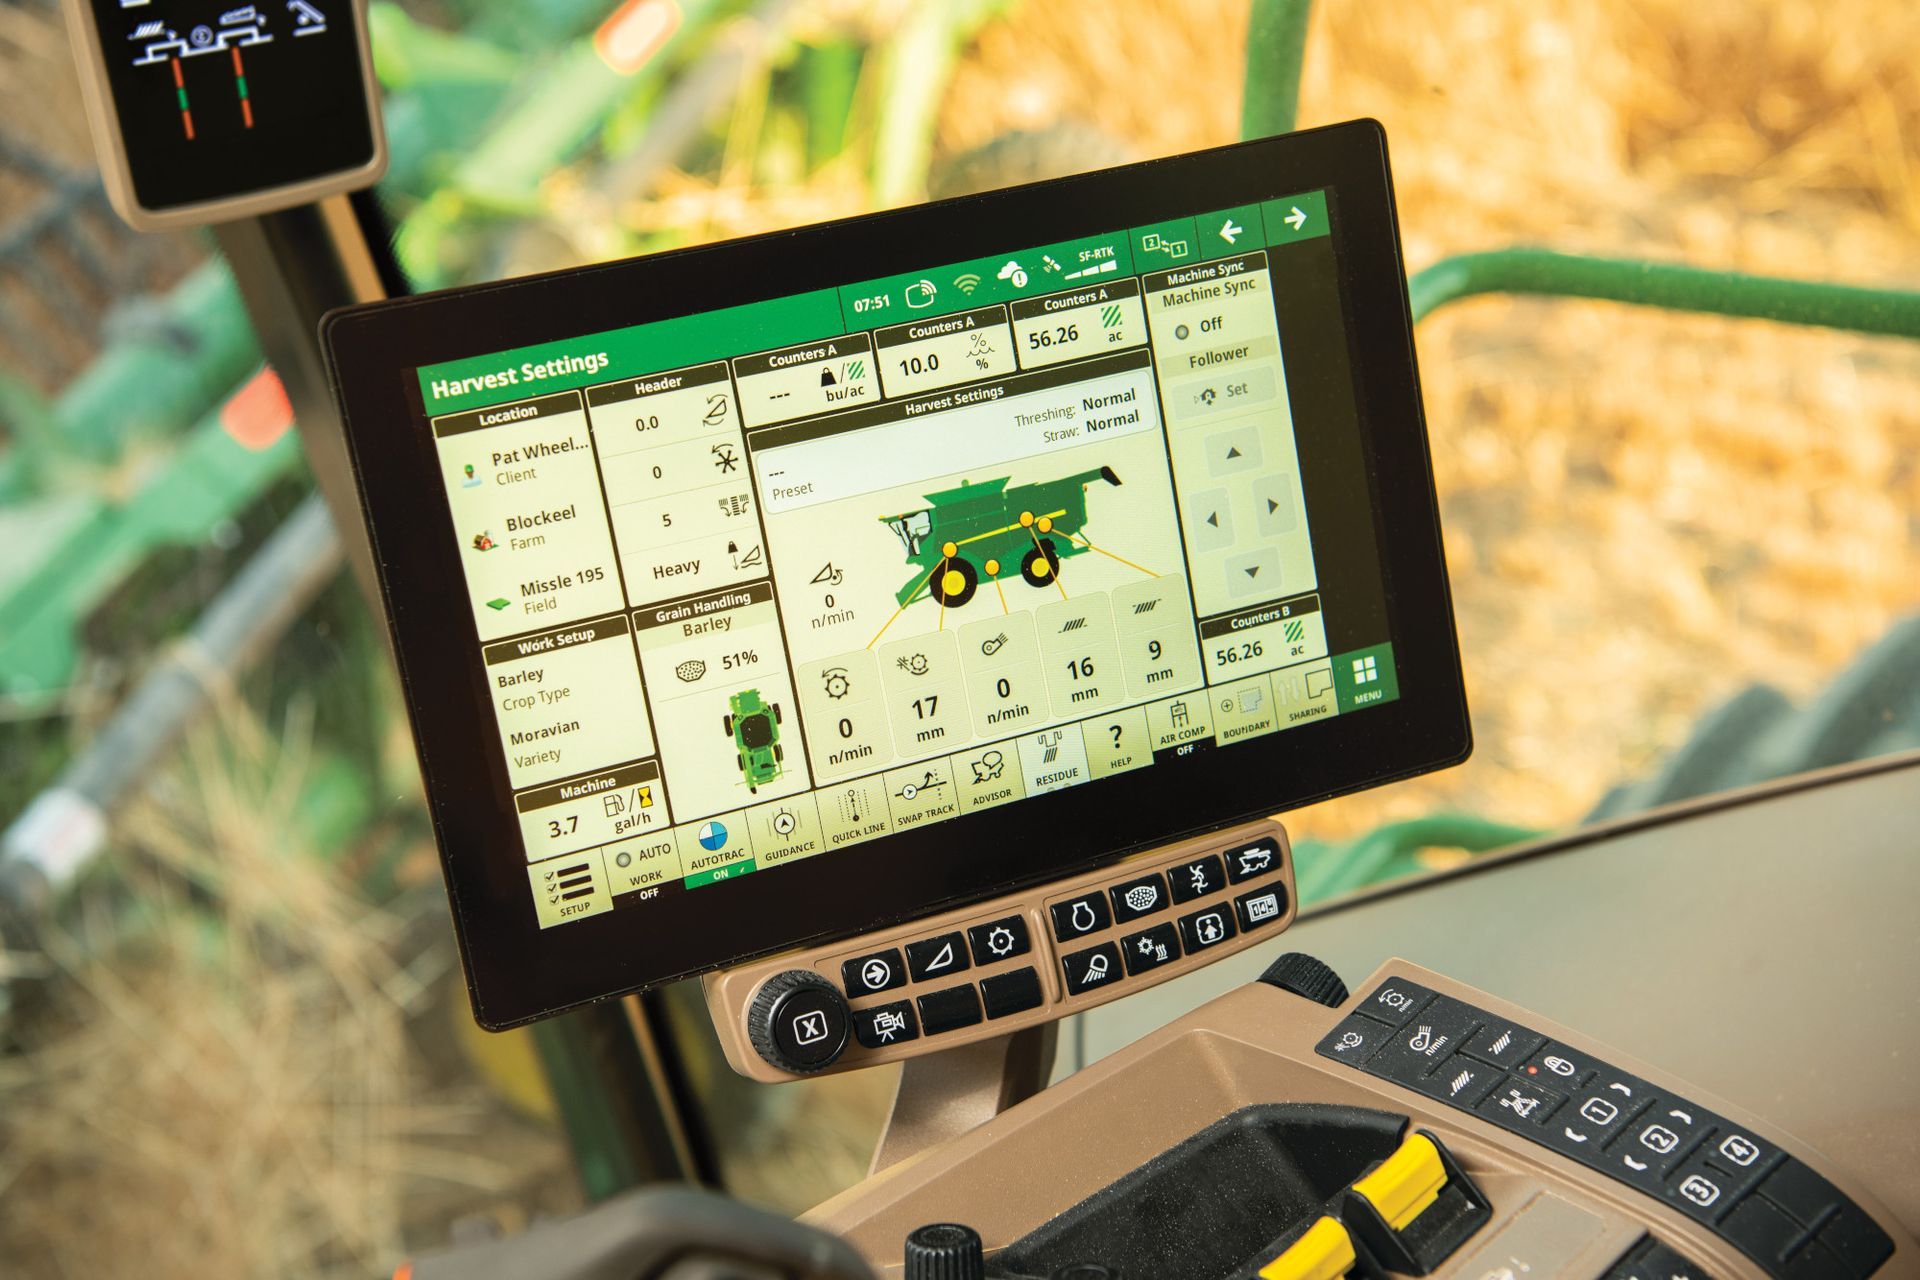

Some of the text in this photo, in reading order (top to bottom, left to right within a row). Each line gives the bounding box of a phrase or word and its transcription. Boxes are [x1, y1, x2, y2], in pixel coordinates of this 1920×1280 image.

[1078, 246, 1114, 262] SF-RTK
[1168, 261, 1244, 286] Machine Sync
[1044, 288, 1108, 312] Counters A
[1162, 278, 1256, 307] Machine Sync
[854, 295, 890, 313] 07:51
[909, 316, 974, 339] Counters A
[1200, 316, 1222, 333] Off
[1029, 324, 1079, 350] 56.26
[1109, 331, 1123, 343] ac
[768, 344, 837, 368] Counters A
[899, 353, 939, 376] 10.0
[976, 358, 988, 370] %
[1189, 346, 1250, 368] Follower
[431, 350, 610, 400] Harvest Settings
[634, 376, 682, 396] Header
[826, 384, 865, 402] bu/ac
[1226, 382, 1248, 398] Set
[905, 385, 1004, 416] Harvest Settings
[1014, 388, 1136, 428] Threshing: Normal
[479, 404, 538, 426] Location
[635, 416, 660, 433] 0.0
[1043, 410, 1140, 444] Straw: Normal
[492, 437, 589, 467] Pat Wheel...
[496, 467, 537, 486] Client
[652, 466, 662, 480] 0
[772, 482, 814, 500] Preset
[506, 505, 576, 532] Blockeel
[662, 513, 672, 528] 5
[510, 534, 546, 552] Farm
[653, 558, 701, 580] Heavy
[521, 567, 604, 598] Missle 195
[524, 596, 558, 615] Field
[656, 592, 752, 624] Grain Handling
[825, 594, 835, 608] 0
[683, 615, 732, 637] Barley
[811, 609, 855, 630] n/min
[1230, 606, 1290, 630] Counters B
[518, 629, 596, 656] Work Setup
[1148, 640, 1162, 660] 9
[1290, 645, 1304, 656] ac
[722, 650, 758, 670] 51%
[1216, 641, 1263, 666] 56.26
[498, 668, 544, 688] Barley
[1066, 657, 1094, 681] 16
[1146, 668, 1174, 684] mm
[996, 678, 1011, 699] 0
[1071, 687, 1100, 703] mm
[1354, 690, 1382, 704] MENU
[502, 686, 571, 712] Crop Type
[911, 696, 939, 721] 17
[987, 704, 1030, 724] n/min
[1288, 704, 1327, 722] SHARING
[510, 720, 580, 746] Moravian
[838, 718, 854, 739] 0
[916, 726, 945, 743] mm
[1160, 726, 1206, 744] AIR COMP
[1223, 720, 1270, 739] BOUNDARY
[514, 749, 562, 768] Variety
[829, 744, 874, 766] n/min
[1177, 744, 1194, 756] OFF
[1110, 756, 1132, 770] HELP
[1036, 768, 1079, 787] RESIDUE
[560, 776, 616, 800] Machine
[972, 789, 1012, 806] ADVISOR
[614, 813, 652, 834] gal/h
[898, 804, 954, 827] SWAP TRACK
[548, 815, 579, 838] 3.7
[832, 822, 886, 844] QUICK LINE
[639, 843, 672, 862] AUTO
[690, 848, 745, 870] AUTOTRAC
[765, 841, 816, 862] GUIDANCE
[630, 870, 663, 887] WORK
[713, 869, 729, 881] ON
[640, 888, 660, 900] OFF
[560, 901, 591, 918] SETUP
[802, 1017, 820, 1038] X
[1425, 1035, 1448, 1056] n/min
[1592, 1106, 1608, 1117] 1
[1650, 1132, 1670, 1148] 2
[1730, 1142, 1749, 1157] 4
[1689, 1182, 1710, 1199] 3
